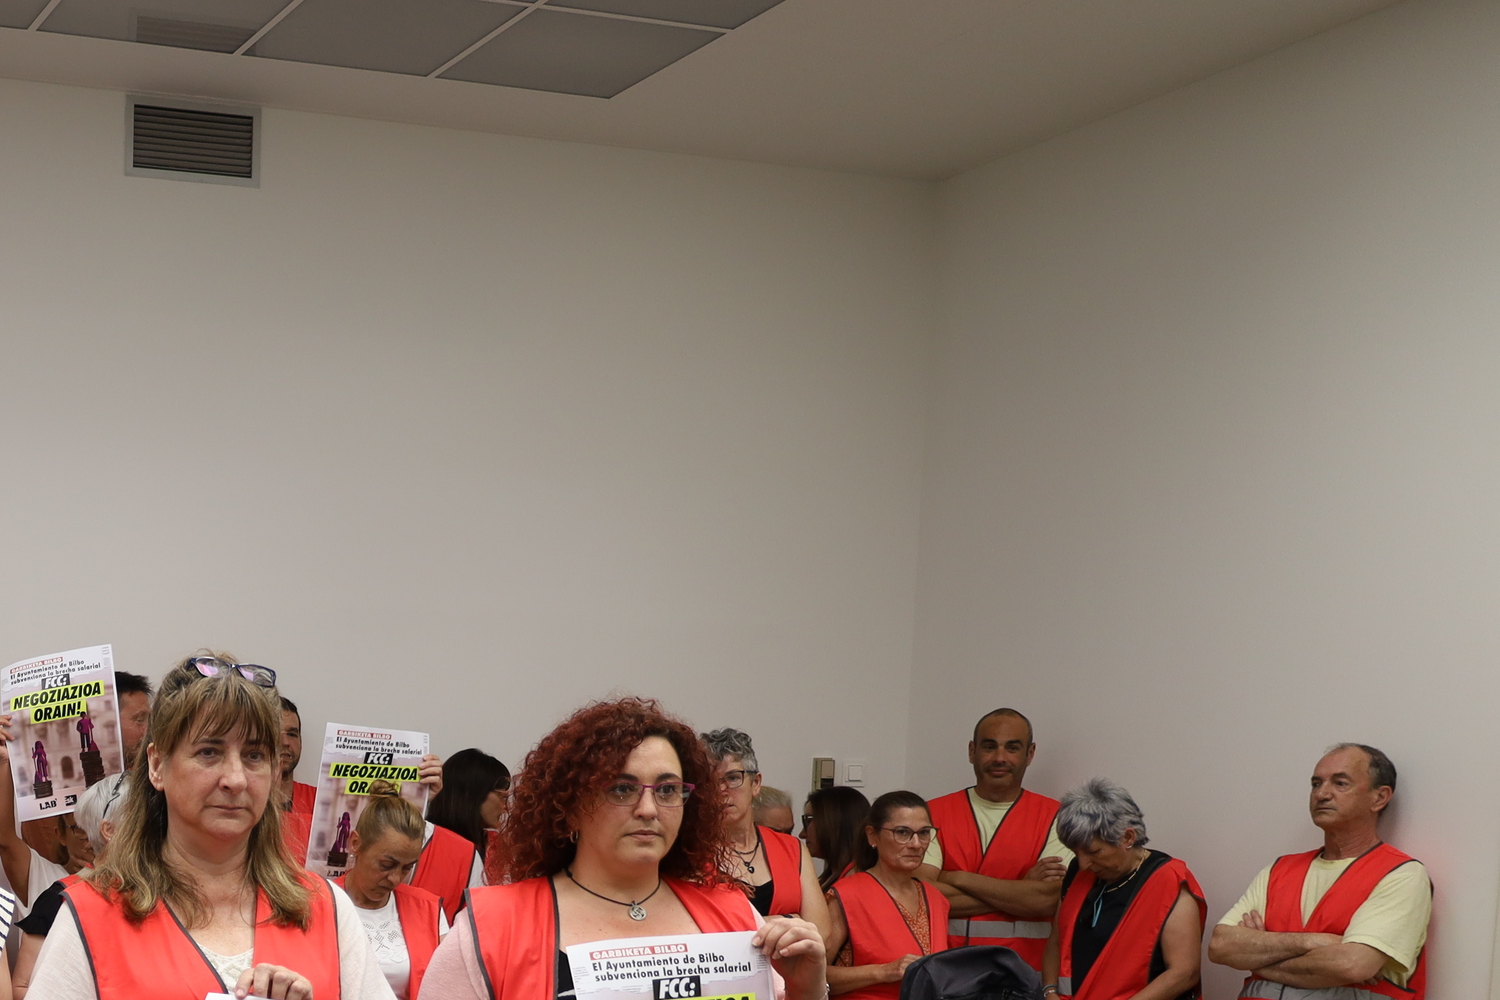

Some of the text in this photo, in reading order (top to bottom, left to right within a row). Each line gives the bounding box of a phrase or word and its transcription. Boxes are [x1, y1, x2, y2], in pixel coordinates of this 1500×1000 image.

[11, 673, 46, 685] subvenciona
[55, 667, 75, 675] brecha
[78, 663, 101, 671] salarial
[17, 664, 58, 679] Ayuntamiento
[45, 676, 67, 689] FCC:
[13, 682, 101, 710] NEGOZIAZIOA
[34, 701, 81, 722] ORAIN!
[336, 743, 372, 751] subvenciona
[344, 737, 384, 746] Ayuntamiento
[367, 754, 390, 764] FCC:
[332, 764, 418, 780] NEGOZIAZIOA
[40, 799, 57, 810] LAB
[593, 944, 685, 960] GARBIKETA BILBO
[592, 952, 725, 972] El Ayuntamiento de Bilbo
[595, 968, 660, 982] subvenciona
[663, 967, 673, 977] la
[677, 965, 710, 976] brecha
[714, 962, 751, 973] salarial
[659, 978, 695, 999] FCC:
